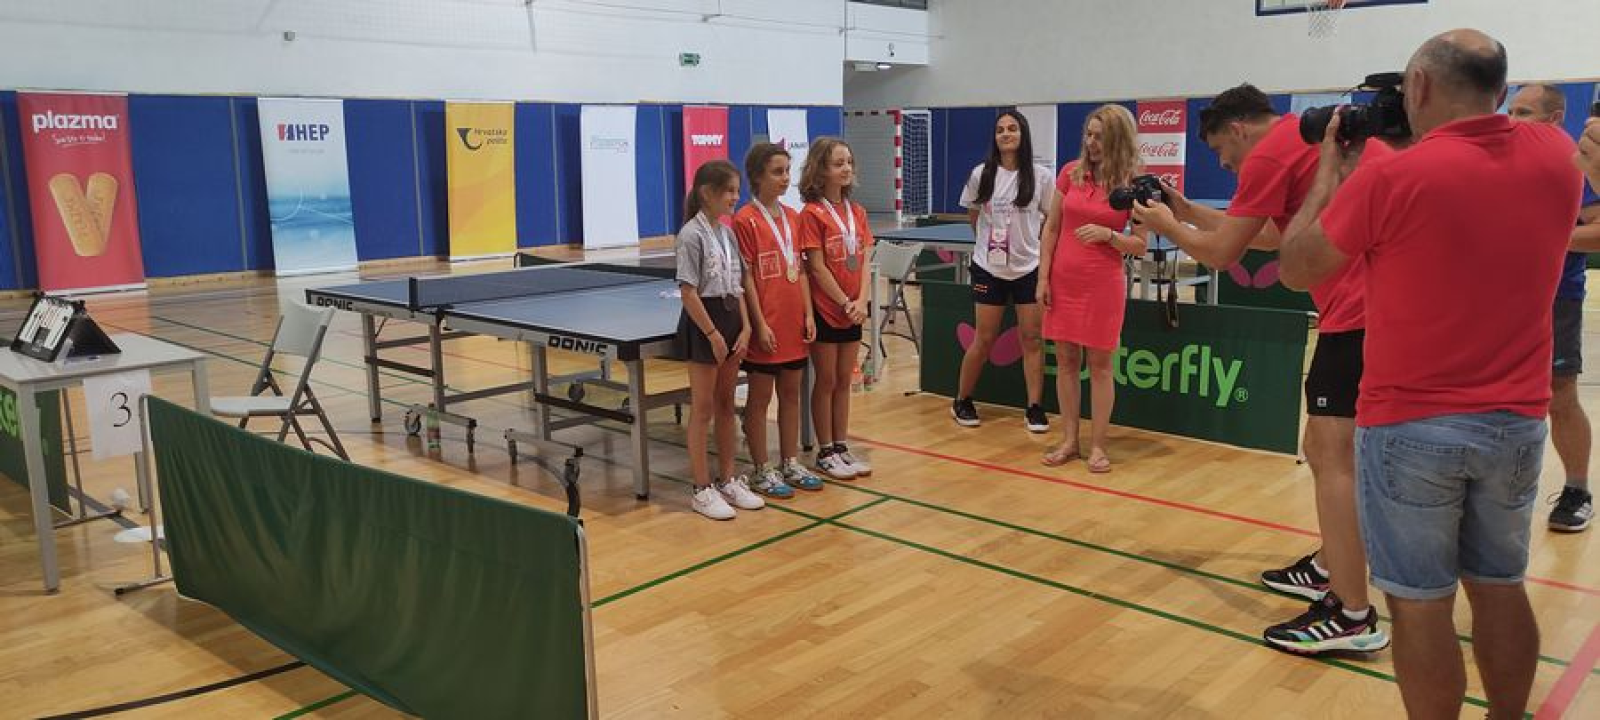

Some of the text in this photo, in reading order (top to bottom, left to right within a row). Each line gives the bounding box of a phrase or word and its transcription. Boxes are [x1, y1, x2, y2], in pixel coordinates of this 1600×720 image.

[32, 110, 118, 134] plazma
[1140, 109, 1182, 127] Coca-Cola
[296, 123, 330, 141] HEP
[316, 296, 353, 311] DONIC
[549, 335, 608, 356] DONIC
[110, 392, 132, 428] 3
